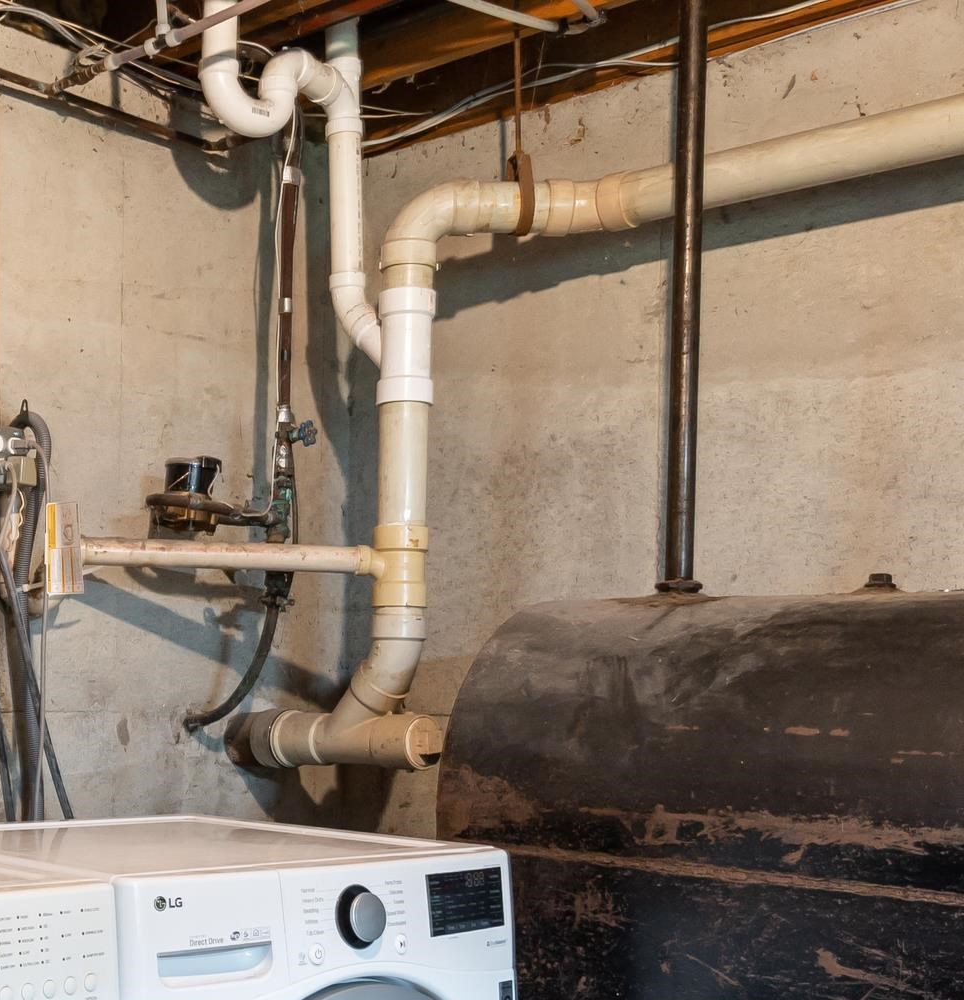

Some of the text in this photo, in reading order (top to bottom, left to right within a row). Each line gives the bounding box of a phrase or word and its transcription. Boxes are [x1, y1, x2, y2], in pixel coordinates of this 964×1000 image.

[168, 897, 183, 908] LG
[189, 937, 224, 947] Direct Drive
